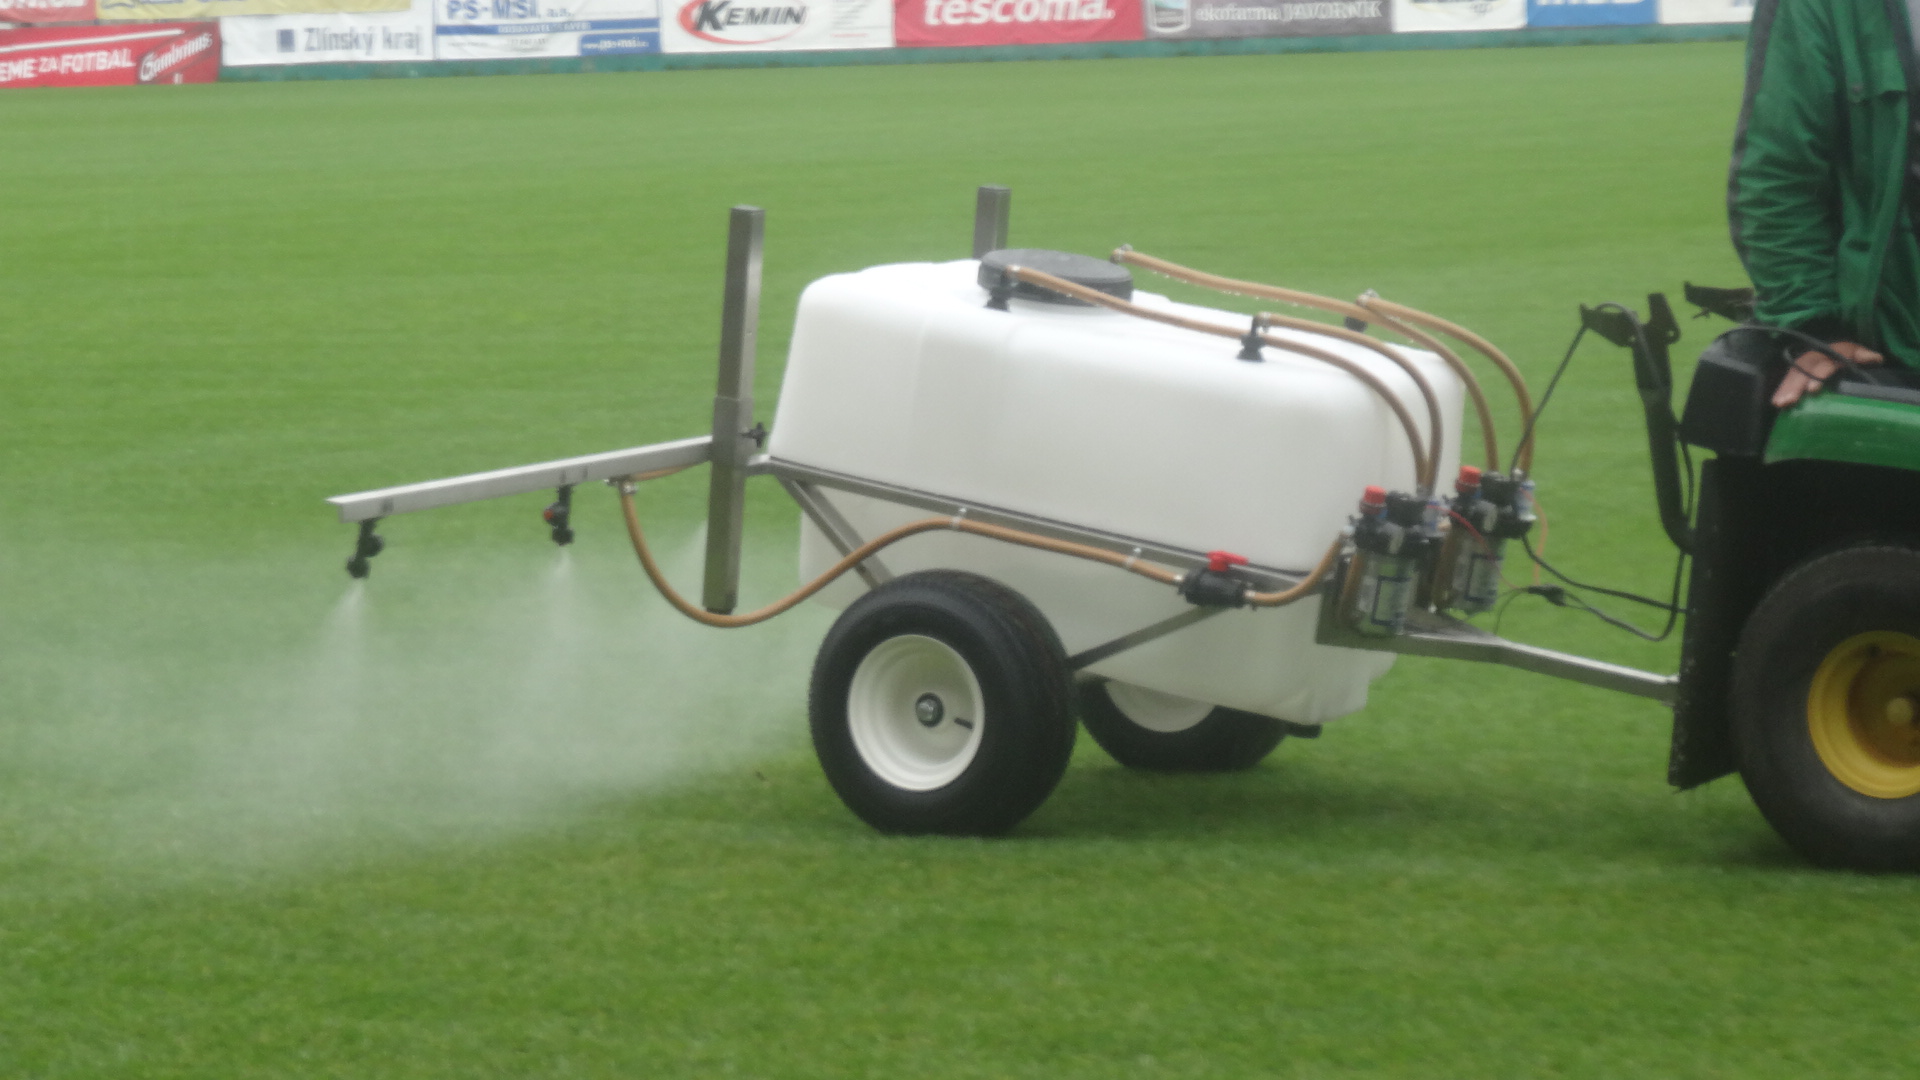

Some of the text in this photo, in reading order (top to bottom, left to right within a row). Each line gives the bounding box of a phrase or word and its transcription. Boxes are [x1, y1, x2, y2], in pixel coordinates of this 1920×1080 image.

[382, 26, 422, 55] kraj
[39, 57, 58, 72] ZA
[60, 48, 136, 74] FOTBAL
